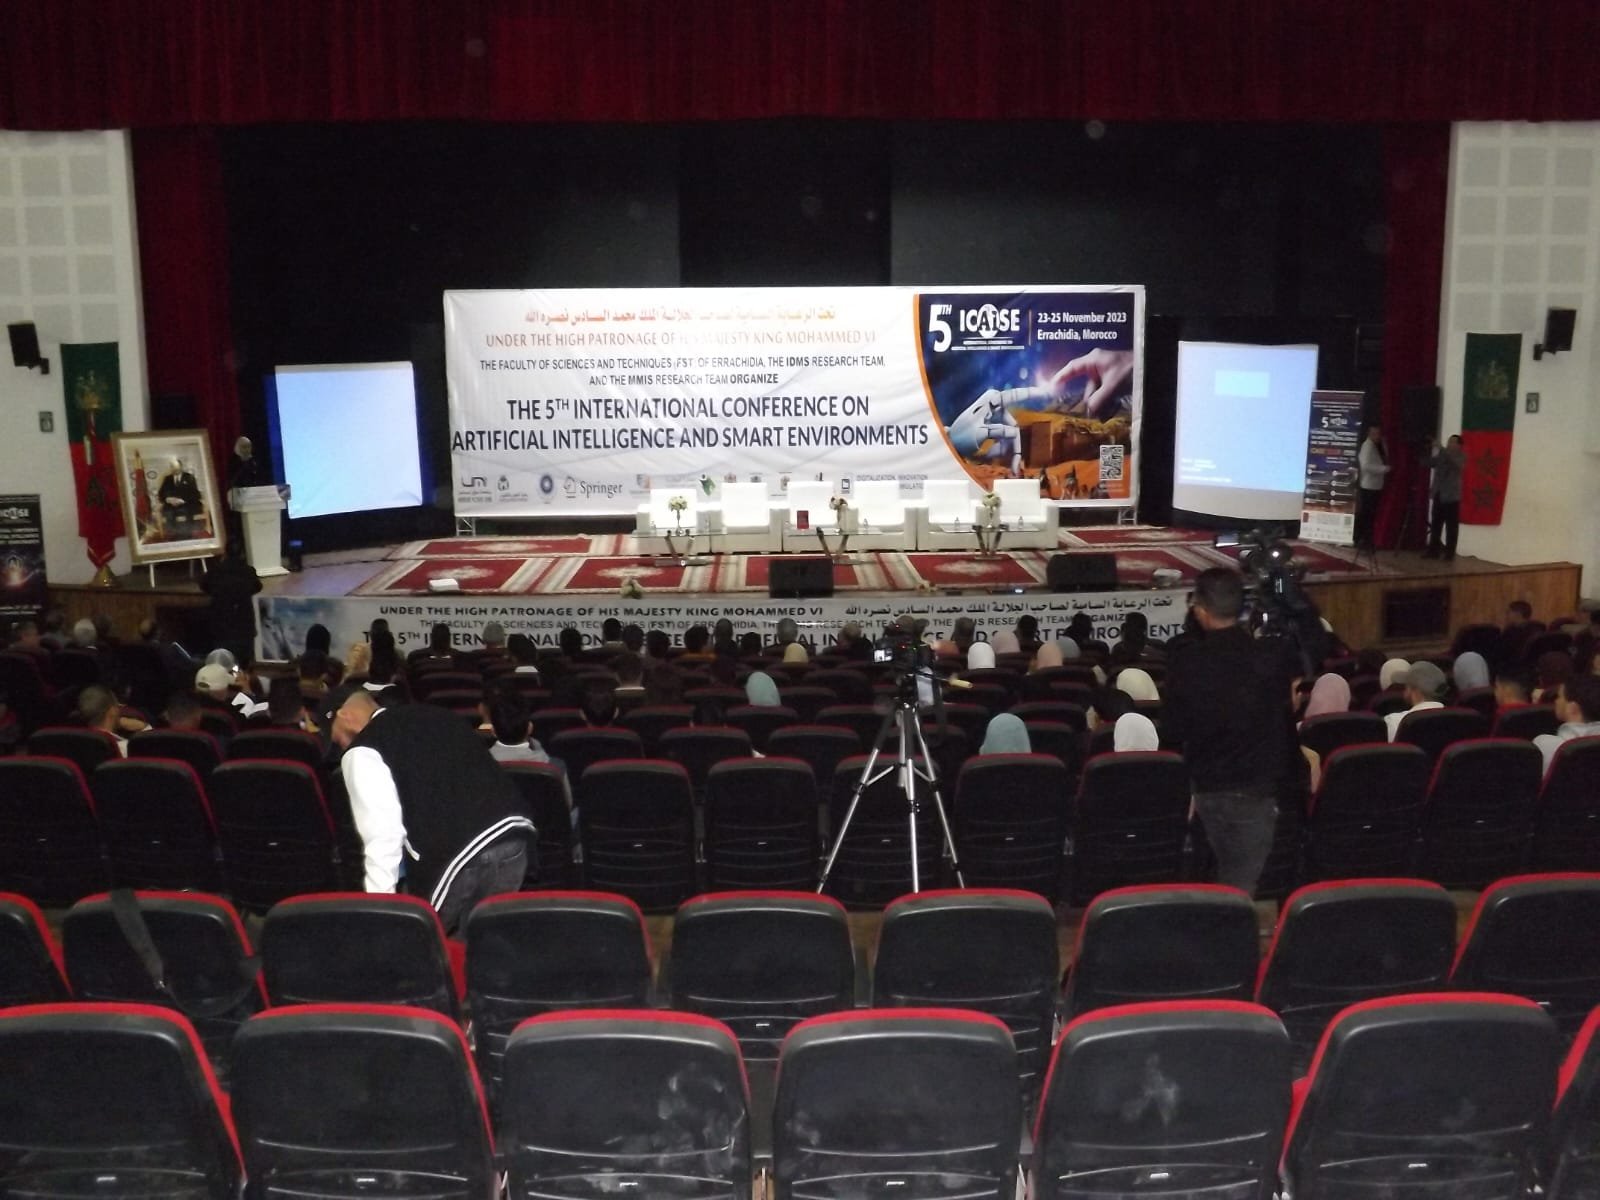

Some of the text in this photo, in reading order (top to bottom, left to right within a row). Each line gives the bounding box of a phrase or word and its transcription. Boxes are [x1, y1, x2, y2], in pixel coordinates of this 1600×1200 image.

[1037, 311, 1127, 323] 23-25 November 2023
[486, 333, 527, 347] UNDER
[531, 333, 552, 347] THE
[555, 333, 585, 346] HIGH
[588, 332, 657, 346] PATRONAGE
[661, 332, 676, 345] OF
[754, 330, 783, 344] KING
[786, 330, 861, 344] MOHAMMED
[864, 330, 877, 344] VI
[1037, 329, 1117, 342] Errachidia, Morocco
[480, 359, 497, 371] THE
[498, 359, 537, 371] FACULTY
[538, 359, 551, 370] OF
[552, 358, 595, 370] SCIENCES
[597, 358, 615, 370] AND
[617, 357, 672, 370] TECHNIQUES
[698, 357, 710, 368] OF
[712, 356, 766, 369] ERRACHIDIA,
[768, 356, 784, 368] THE
[786, 356, 810, 368] IDMS
[812, 355, 859, 367] RESEARCH
[589, 373, 779, 386] AND THE MMIS RESEARCH TEAM ORGANIZE
[507, 395, 869, 420] THE 5TH INTERNATIONAL CONFERENCE ON
[452, 424, 928, 451] ARTIFICIAL INTELLIGENCE AND SMART ENVIRONMENTS
[579, 480, 623, 499] Springer
[380, 606, 823, 616] UNDER THE HIGH PATRONAGE OF HIS MAJESTY KING MOHAMMED VI
[845, 596, 1172, 618] تحت الرعاية السامية لصاحب الجلالة الملك محمد السادس نصره الله
[503, 620, 554, 629] SCIENCES
[556, 620, 578, 629] AND
[677, 620, 691, 629] OF
[933, 617, 953, 627] THE
[398, 632, 420, 645] 5TH
